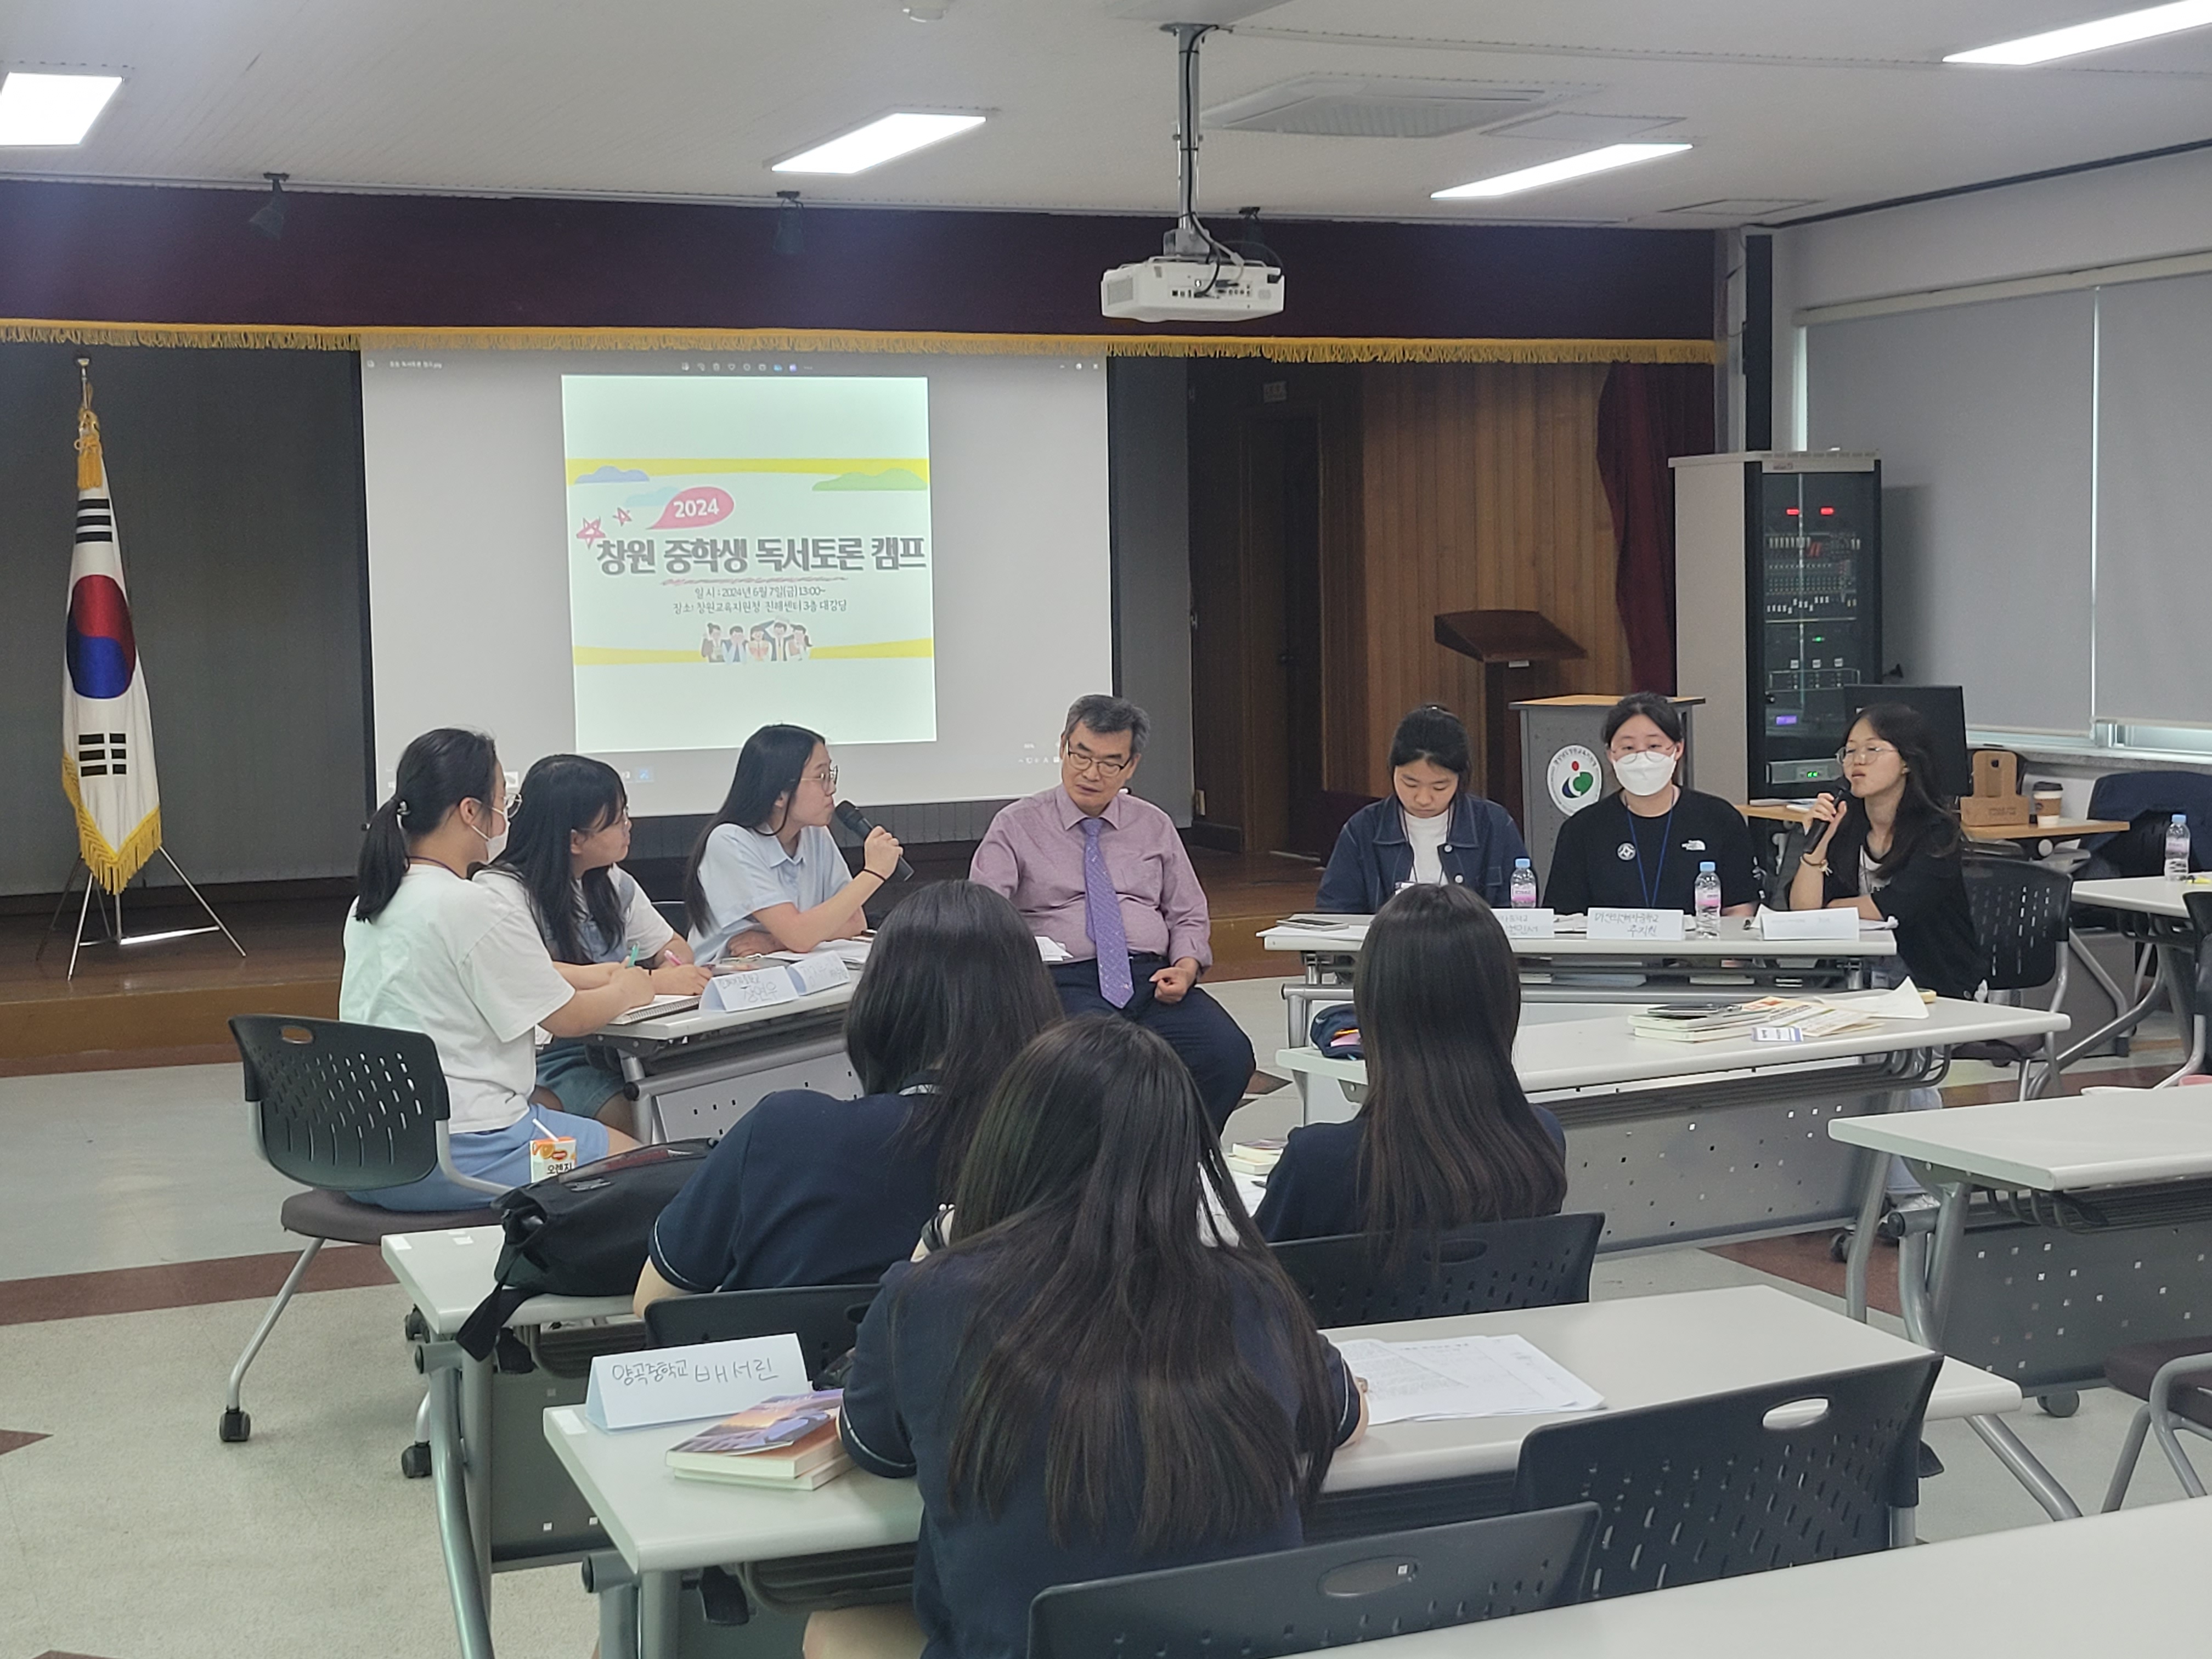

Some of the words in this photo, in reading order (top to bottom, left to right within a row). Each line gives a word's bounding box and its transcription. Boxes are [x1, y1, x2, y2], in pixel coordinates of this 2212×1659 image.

[673, 498, 720, 518] 2024
[596, 539, 656, 575] 창원
[663, 538, 748, 573] 중학생
[755, 537, 865, 572] 독서토론
[871, 537, 927, 571] 캠프
[753, 586, 767, 598] 6월
[697, 600, 760, 614] 창원교육지원청
[547, 1163, 572, 1175] 오렌지
[612, 1359, 689, 1386] 양곡중학교
[695, 1357, 778, 1383] 배서린
